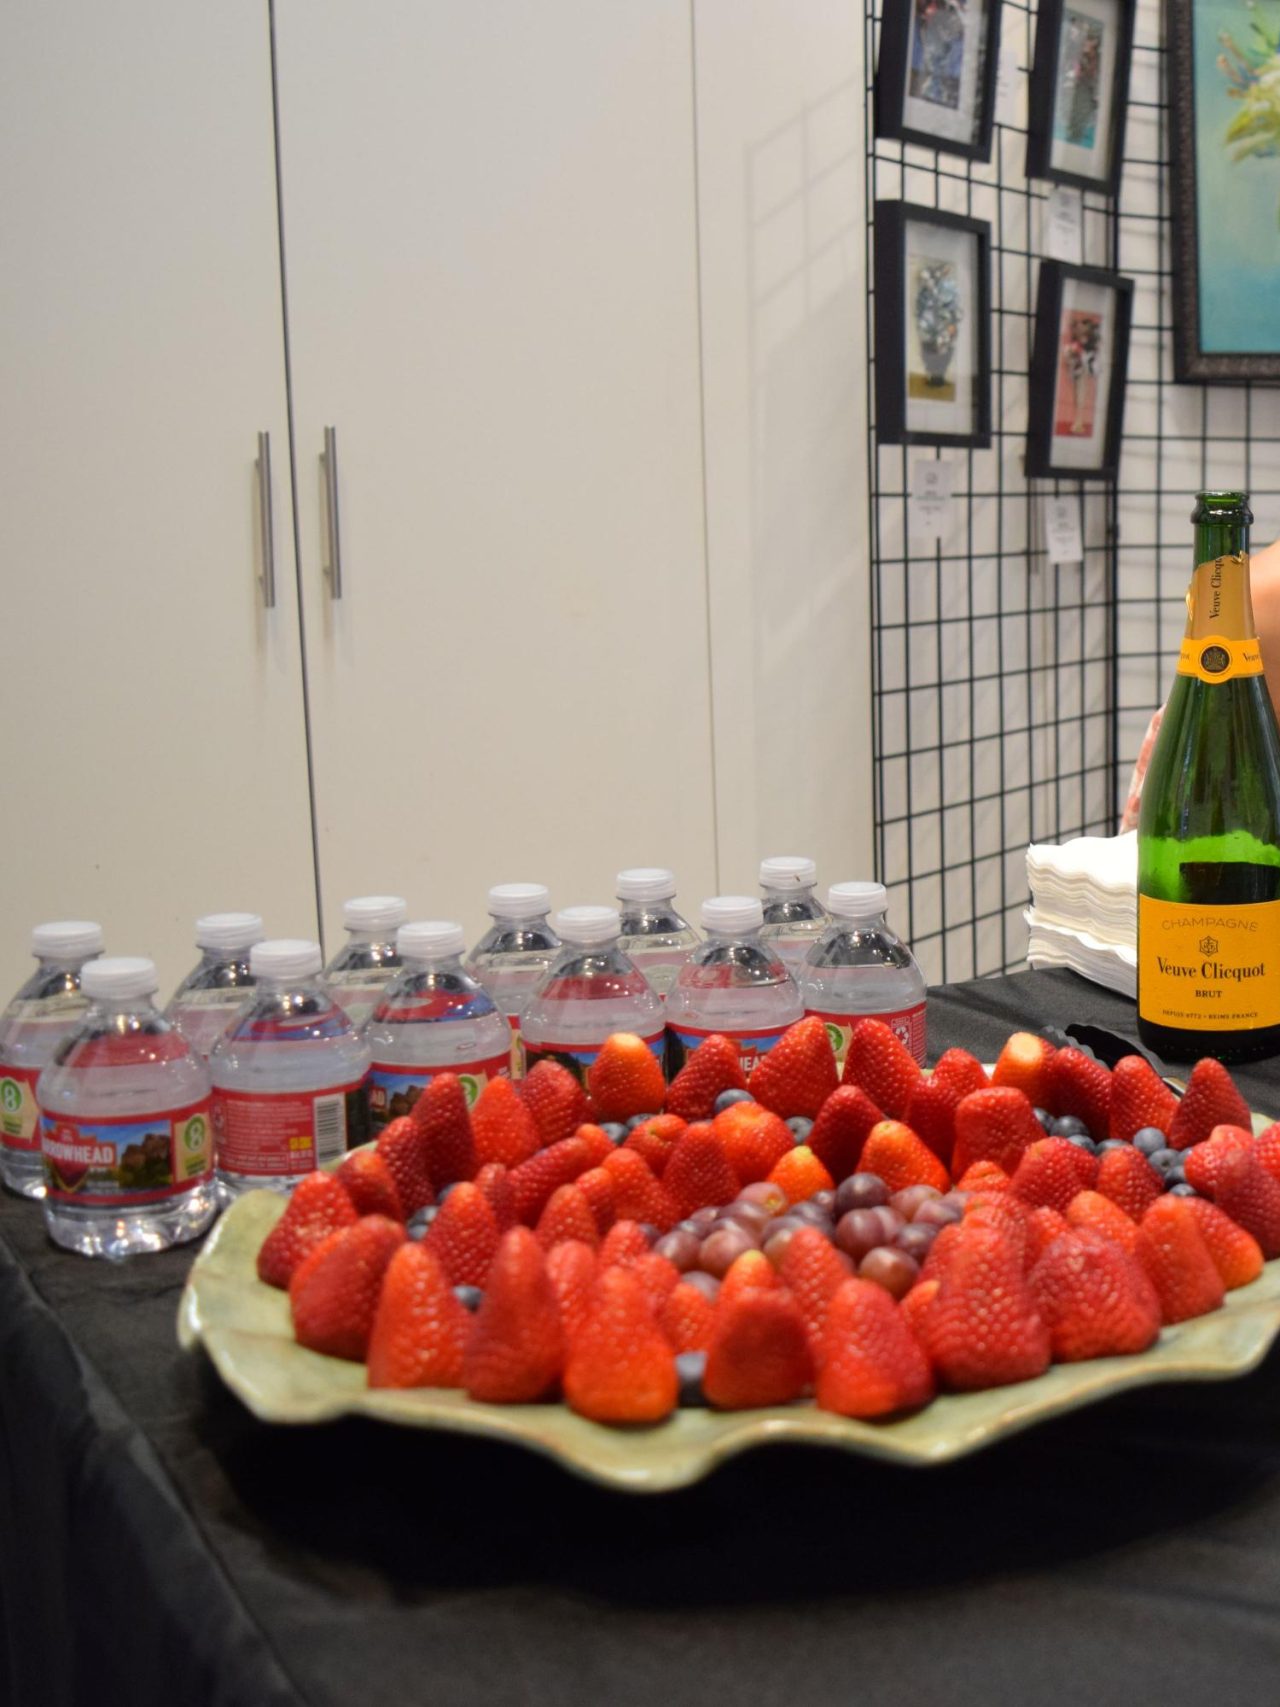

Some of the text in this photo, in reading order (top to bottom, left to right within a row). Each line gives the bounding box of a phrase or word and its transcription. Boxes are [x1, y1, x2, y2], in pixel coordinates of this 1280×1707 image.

[1209, 591, 1221, 619] Veuve
[1161, 918, 1258, 932] CHAMPAGNE
[1157, 956, 1265, 982] Veuve Clicquot
[1195, 989, 1223, 998] BRUT
